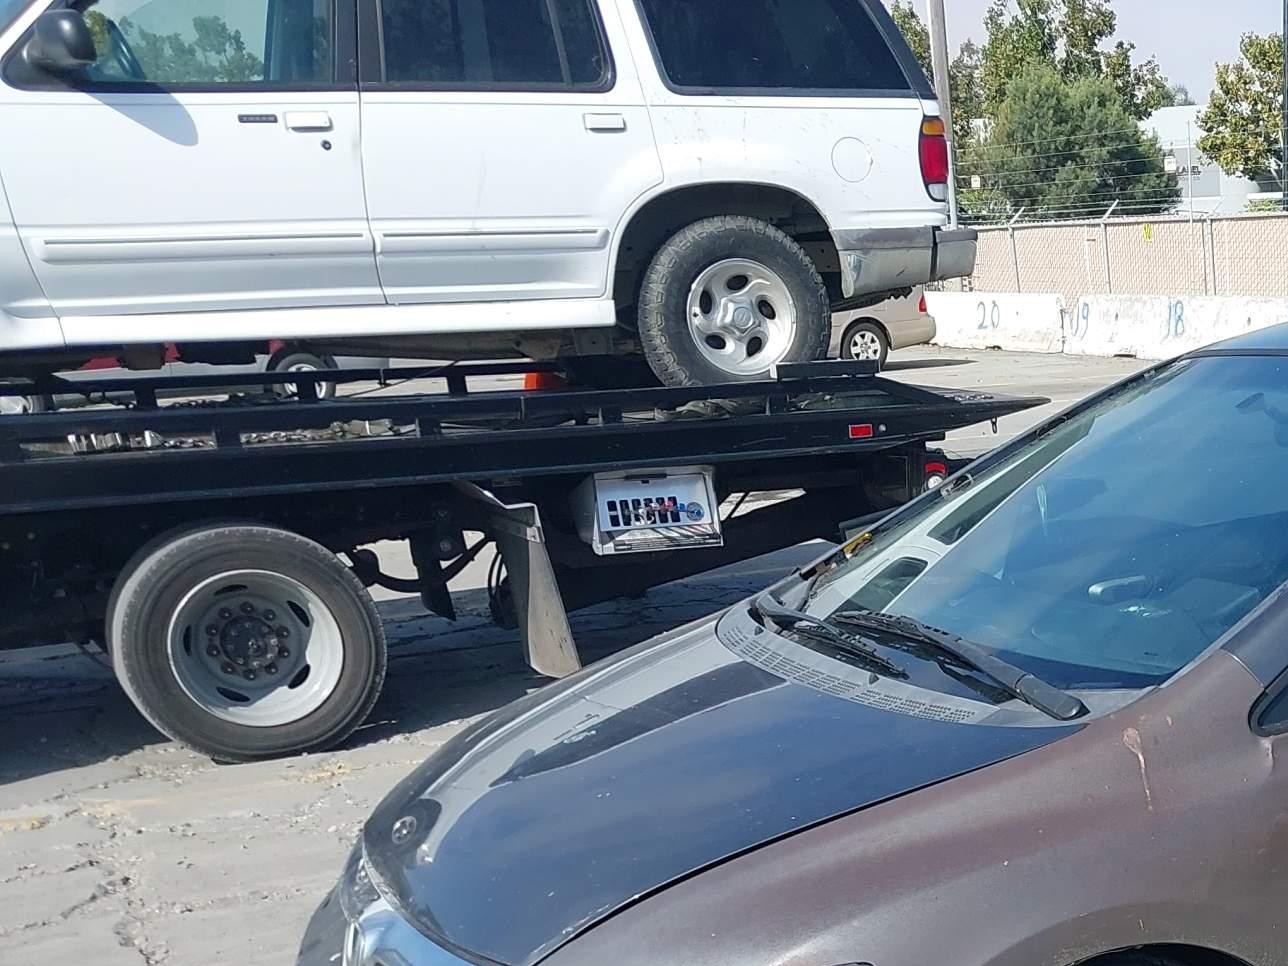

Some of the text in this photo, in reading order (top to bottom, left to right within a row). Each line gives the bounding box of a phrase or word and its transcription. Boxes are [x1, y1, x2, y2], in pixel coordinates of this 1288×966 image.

[976, 300, 1000, 330] 20
[1073, 302, 1089, 340] 19
[1166, 301, 1185, 337] 18
